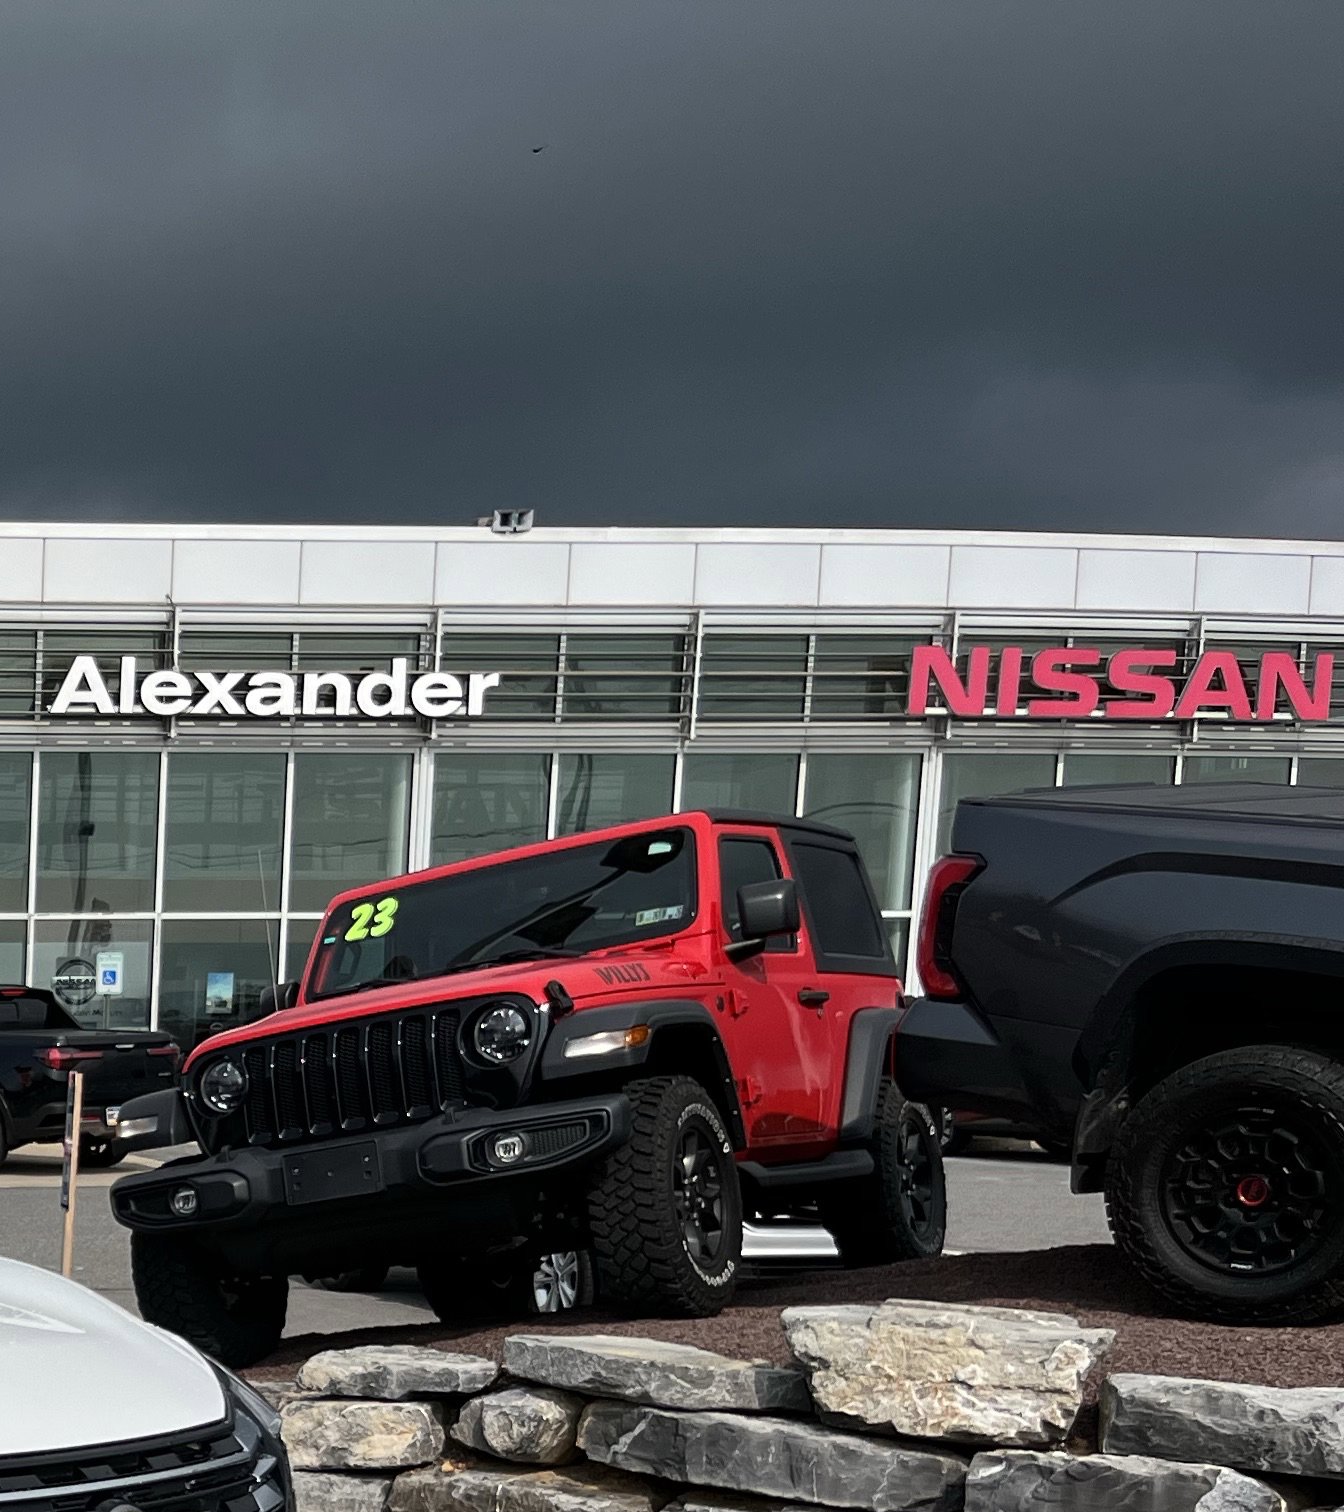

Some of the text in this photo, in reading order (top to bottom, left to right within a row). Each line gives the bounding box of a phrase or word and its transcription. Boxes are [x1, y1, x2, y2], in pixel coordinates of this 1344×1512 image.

[49, 655, 500, 717] Alexander
[907, 645, 1334, 720] NISSAN
[344, 896, 400, 942] 23
[593, 963, 651, 986] WILLYS
